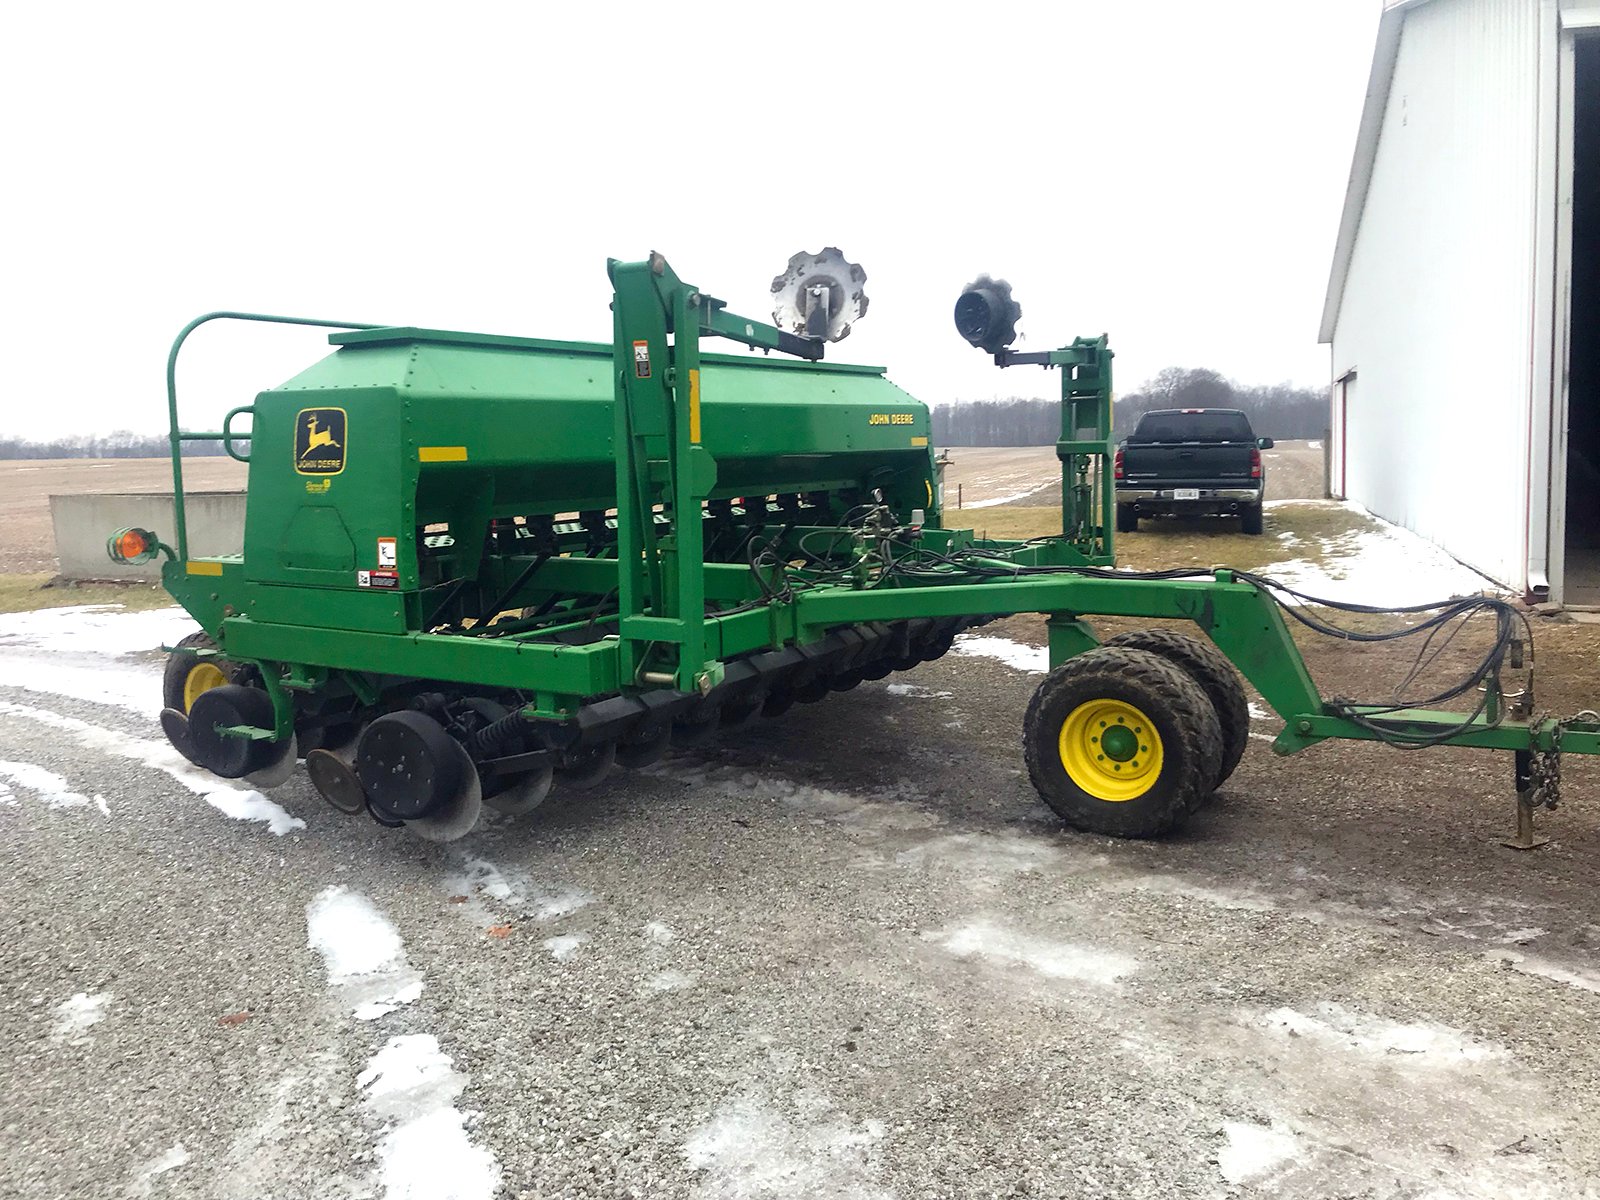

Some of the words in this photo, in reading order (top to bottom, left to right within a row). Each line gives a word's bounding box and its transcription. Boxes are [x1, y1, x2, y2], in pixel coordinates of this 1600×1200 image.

[869, 414, 889, 425] JOHN
[891, 414, 914, 425] DEERE
[297, 460, 317, 469] JOHN
[318, 459, 341, 469] DEERE
